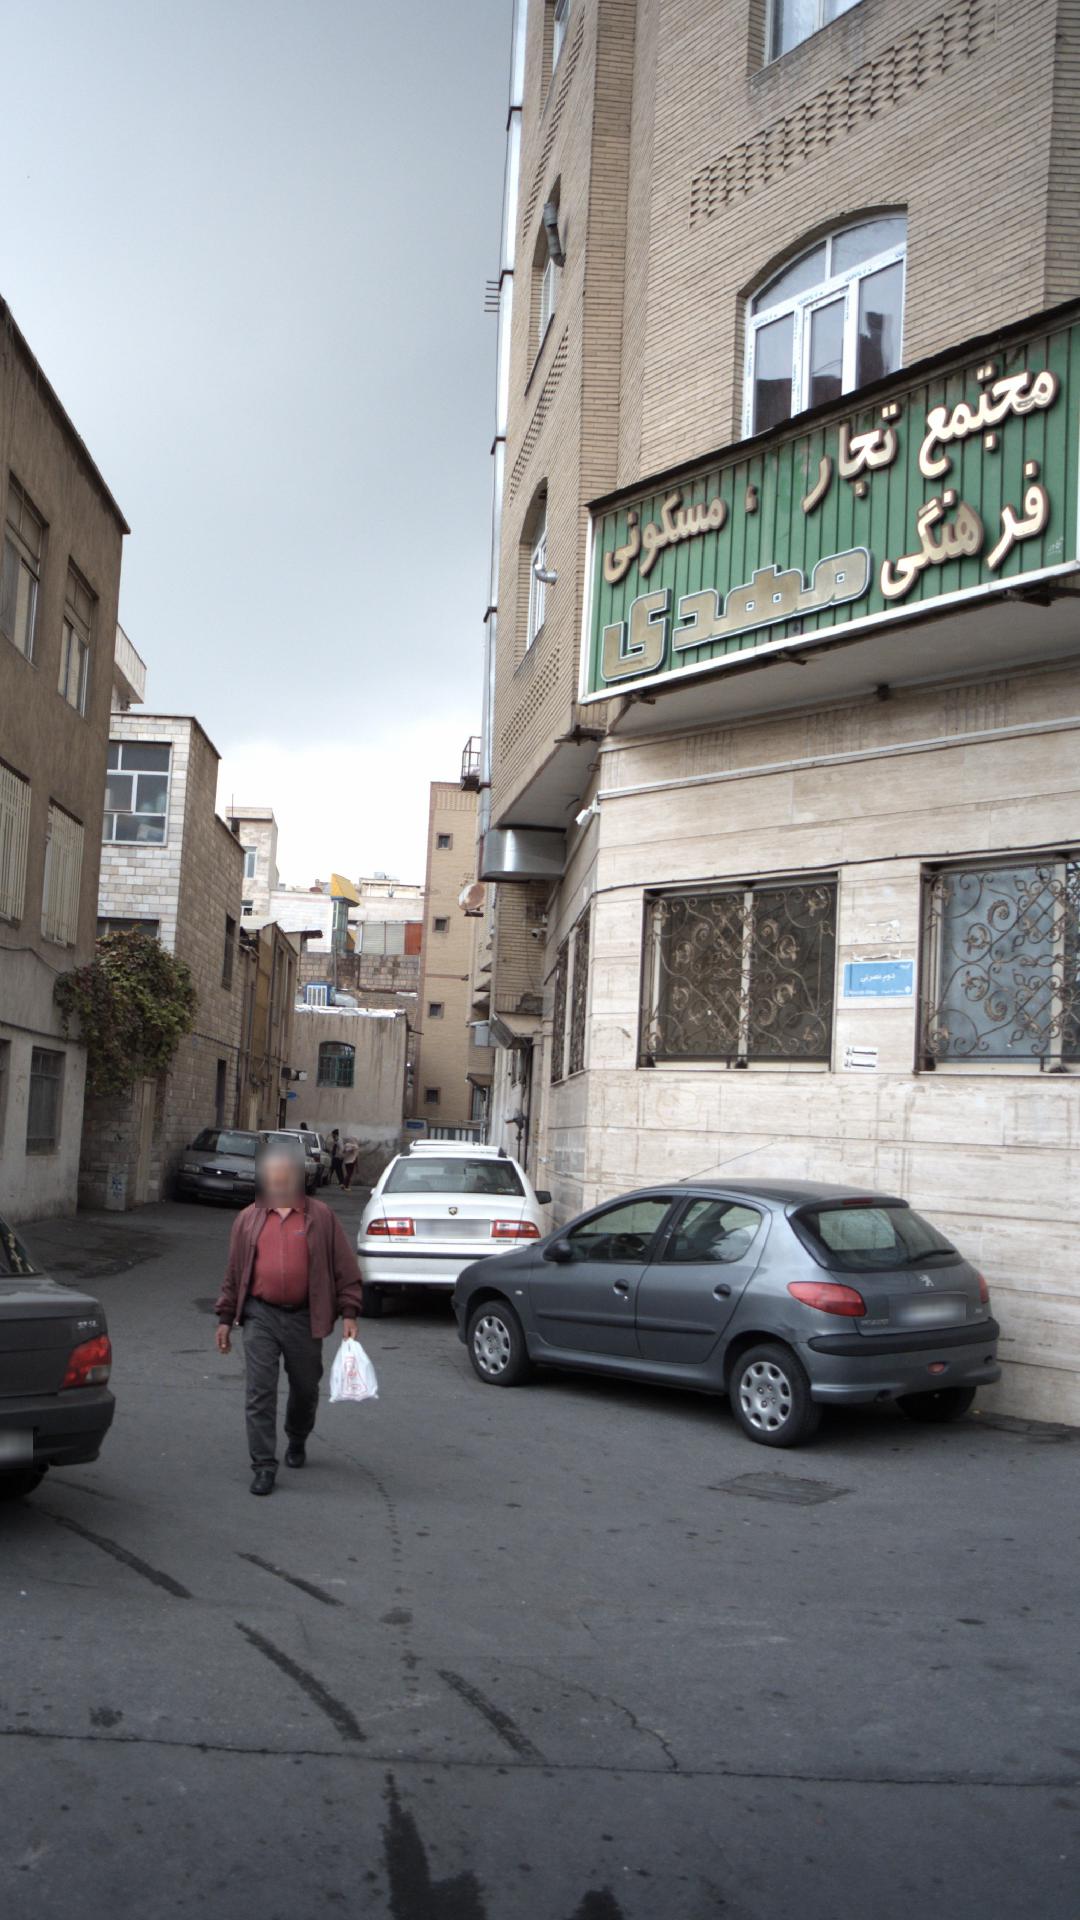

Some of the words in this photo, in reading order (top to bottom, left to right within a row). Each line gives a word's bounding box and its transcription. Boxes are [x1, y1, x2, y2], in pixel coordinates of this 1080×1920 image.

[919, 362, 1059, 479] مجتمع
[604, 493, 728, 584] مسکونی
[880, 460, 1048, 599] فرهنگی
[601, 547, 872, 682] مهدی
